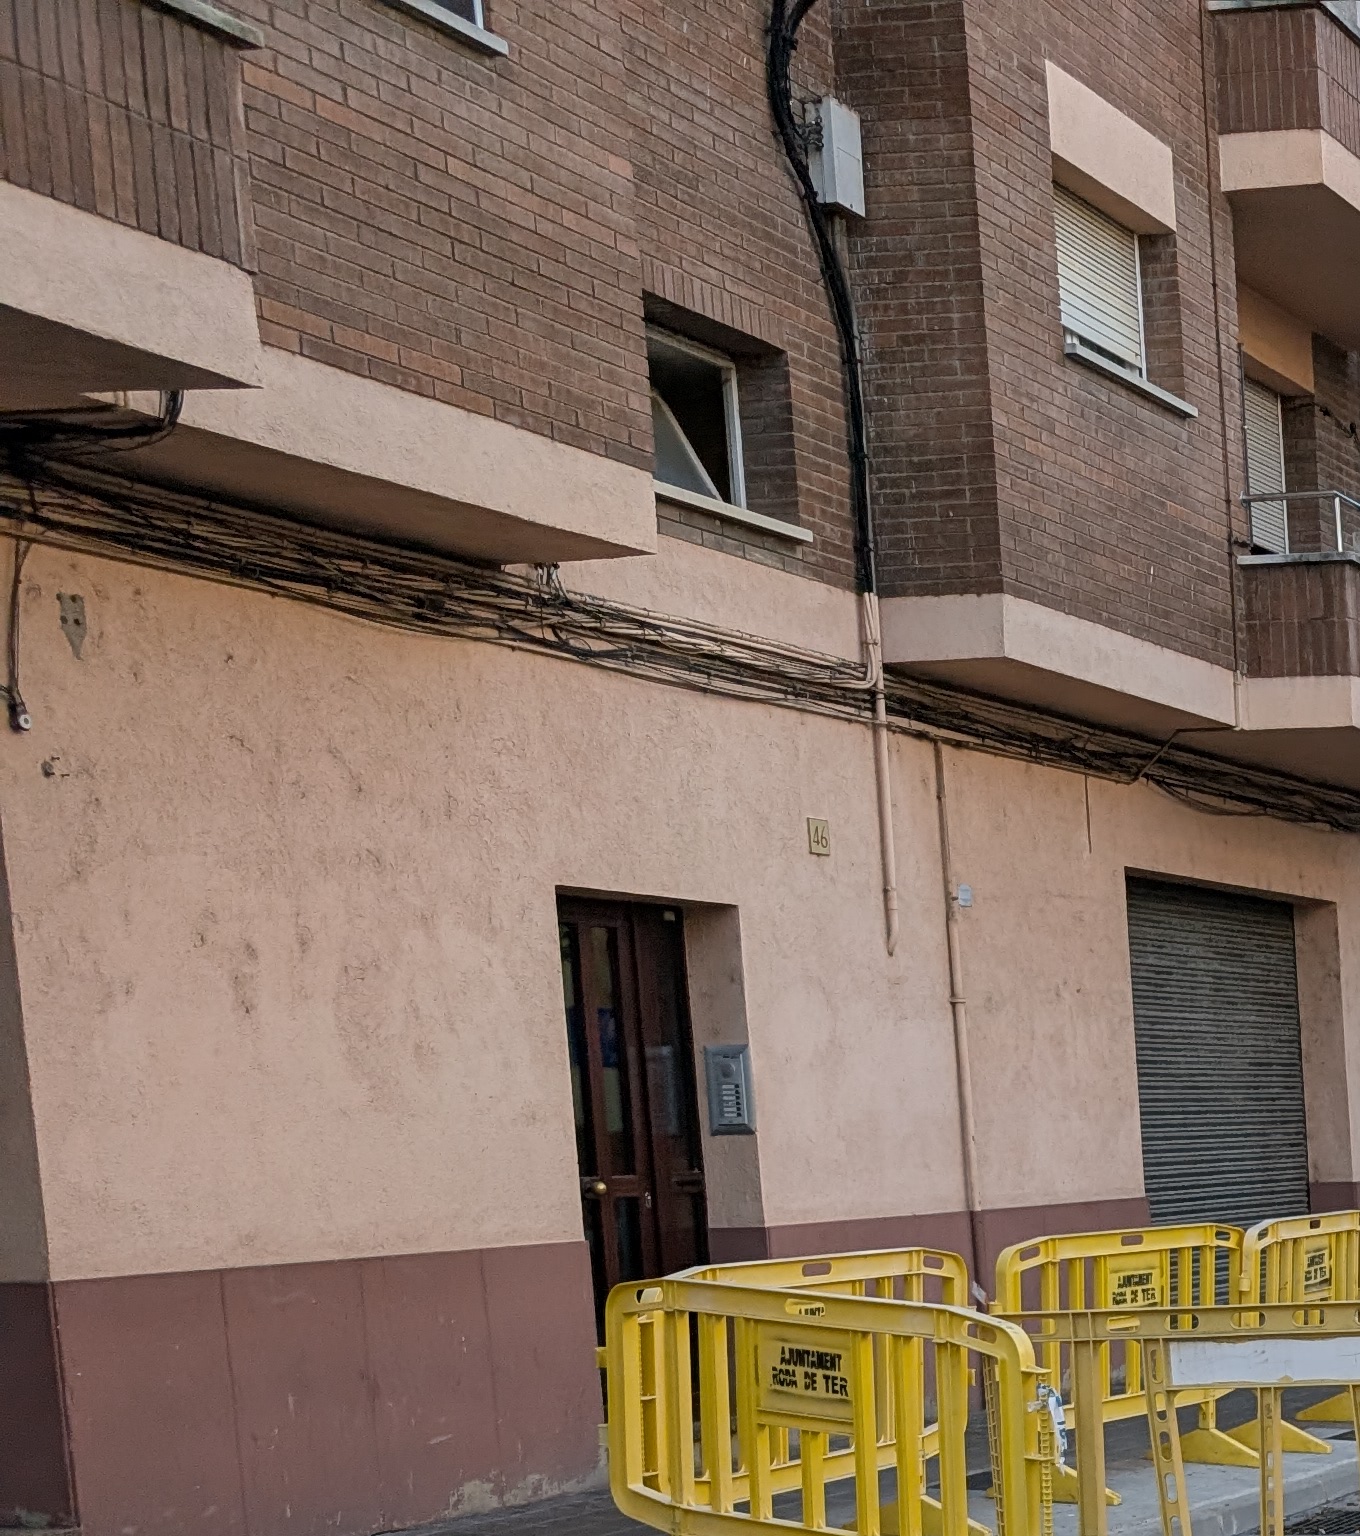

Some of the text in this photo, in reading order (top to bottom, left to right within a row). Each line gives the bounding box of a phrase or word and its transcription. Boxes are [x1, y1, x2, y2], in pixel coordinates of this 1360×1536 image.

[812, 825, 829, 849] 46
[780, 1346, 842, 1373] AJUNTAMENT
[772, 1366, 849, 1398] RODA DE TER
